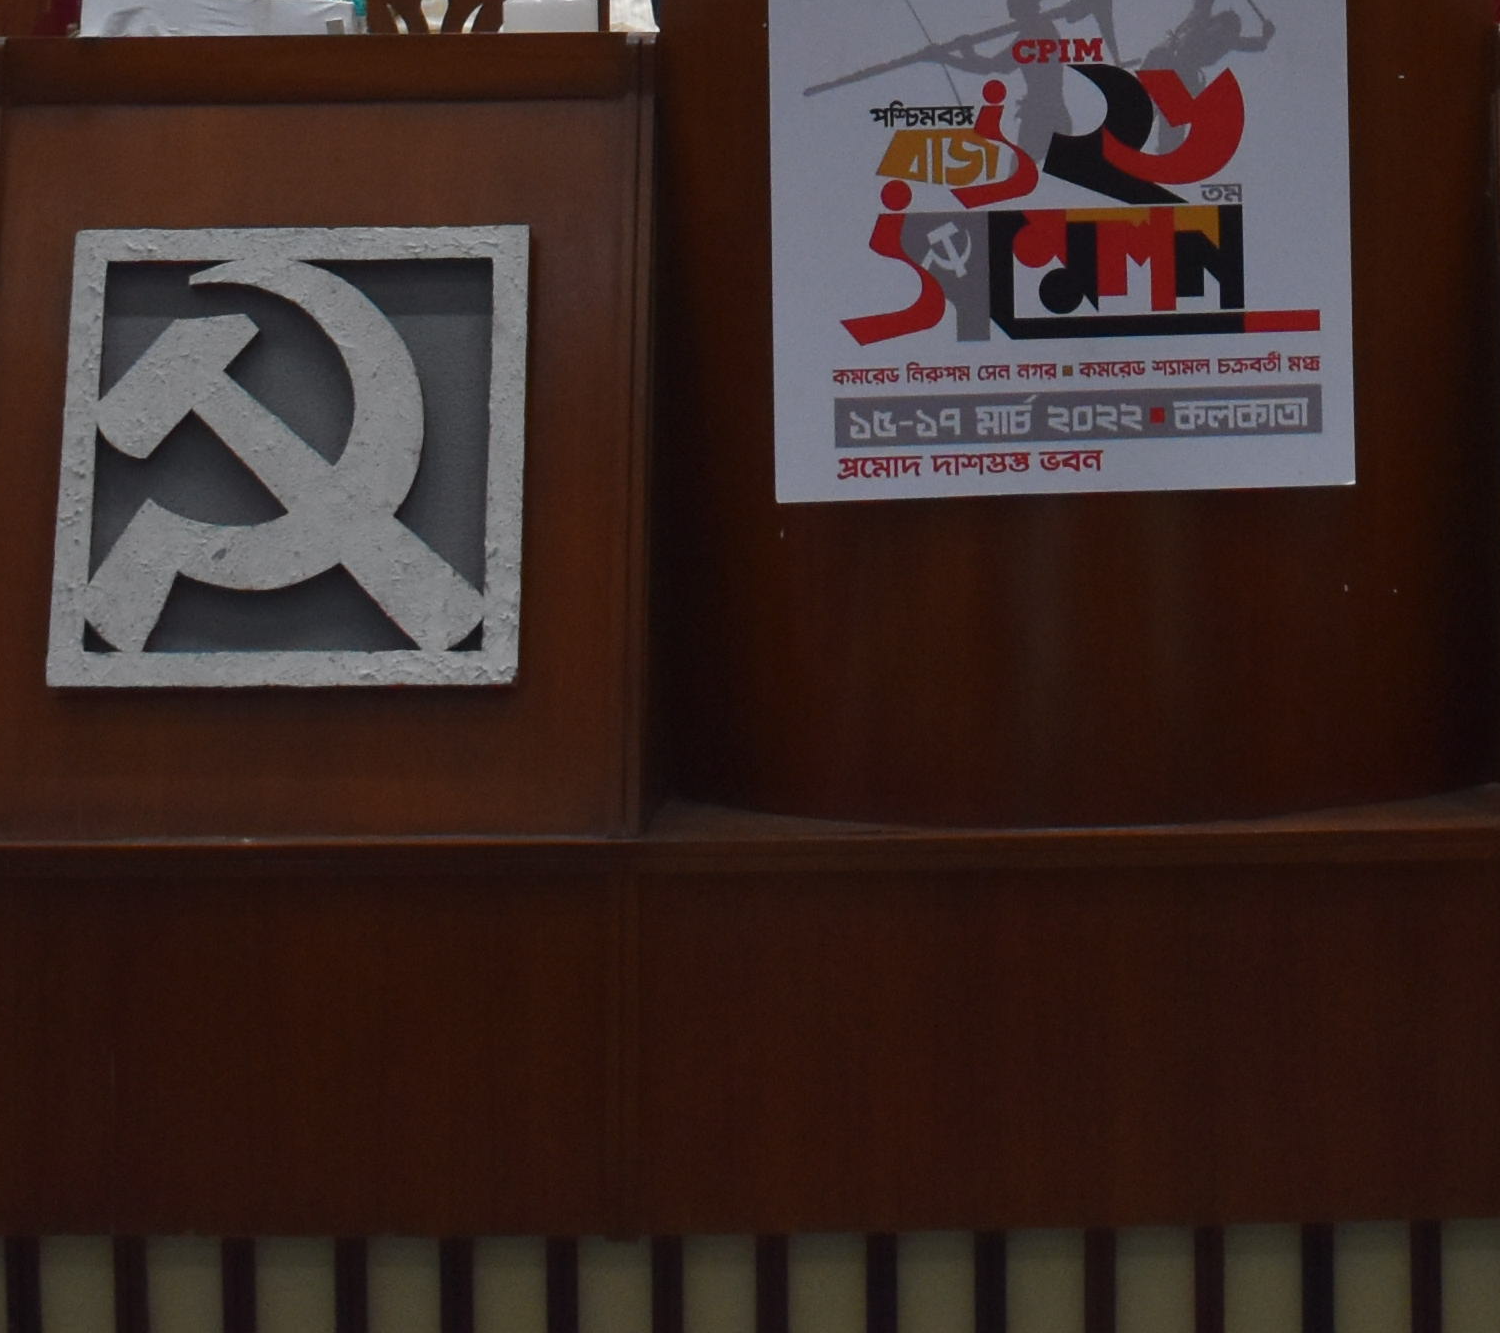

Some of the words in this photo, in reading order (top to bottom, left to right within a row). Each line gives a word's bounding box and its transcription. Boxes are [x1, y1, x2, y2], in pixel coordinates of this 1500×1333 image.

[1013, 38, 1104, 64] CPIM
[870, 100, 974, 128] পশ্চিমবঙ্গ
[833, 368, 899, 385] কমরেড
[907, 361, 970, 383] নিরুপম
[978, 364, 1011, 381] সেন
[1017, 363, 1057, 379] নগর
[1079, 361, 1145, 378] কমরেড
[1152, 359, 1210, 375] শ্যামল
[850, 407, 961, 439] ১৫-১৭
[975, 394, 1038, 435] মার্চ
[1047, 402, 1142, 433] ২০২২
[1173, 397, 1308, 431] কলকাতা
[837, 456, 922, 480] প্রমোদ
[1040, 450, 1103, 473] ভবন
